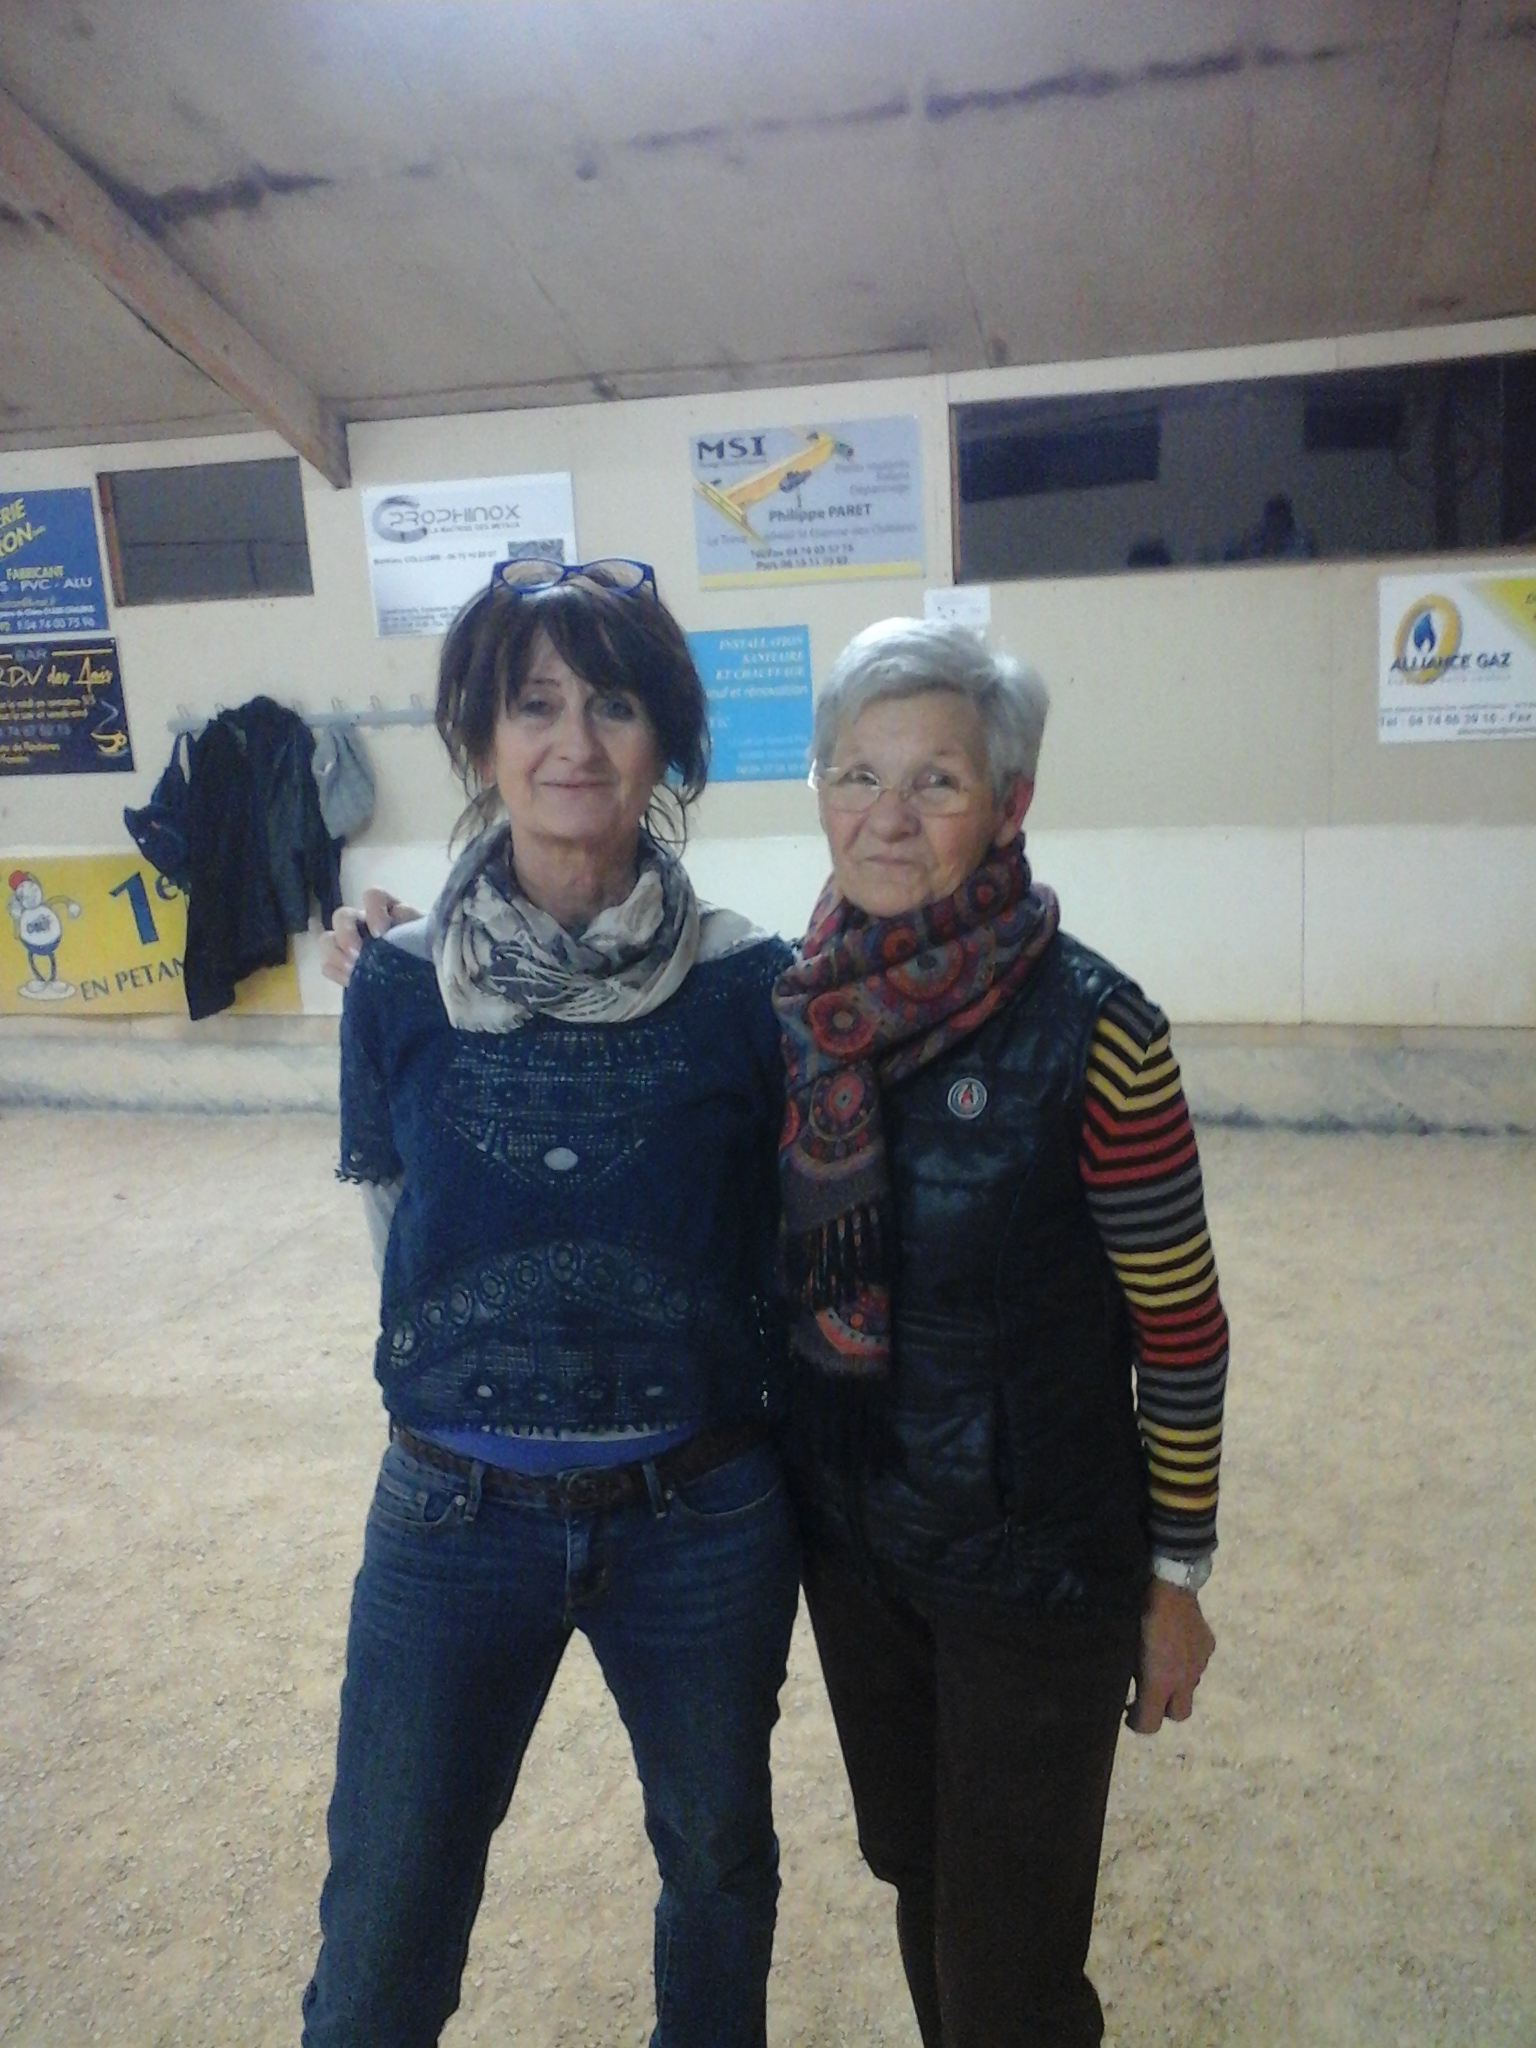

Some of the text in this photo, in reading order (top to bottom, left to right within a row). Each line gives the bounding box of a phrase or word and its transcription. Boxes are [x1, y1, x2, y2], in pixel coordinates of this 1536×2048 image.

[697, 435, 766, 460] MSI
[0, 498, 26, 528] RIE
[769, 503, 872, 523] Philippe PARET
[20, 579, 52, 592] PVC
[1391, 650, 1513, 672] ALLIANCE GAZ
[79, 976, 110, 1001] EN
